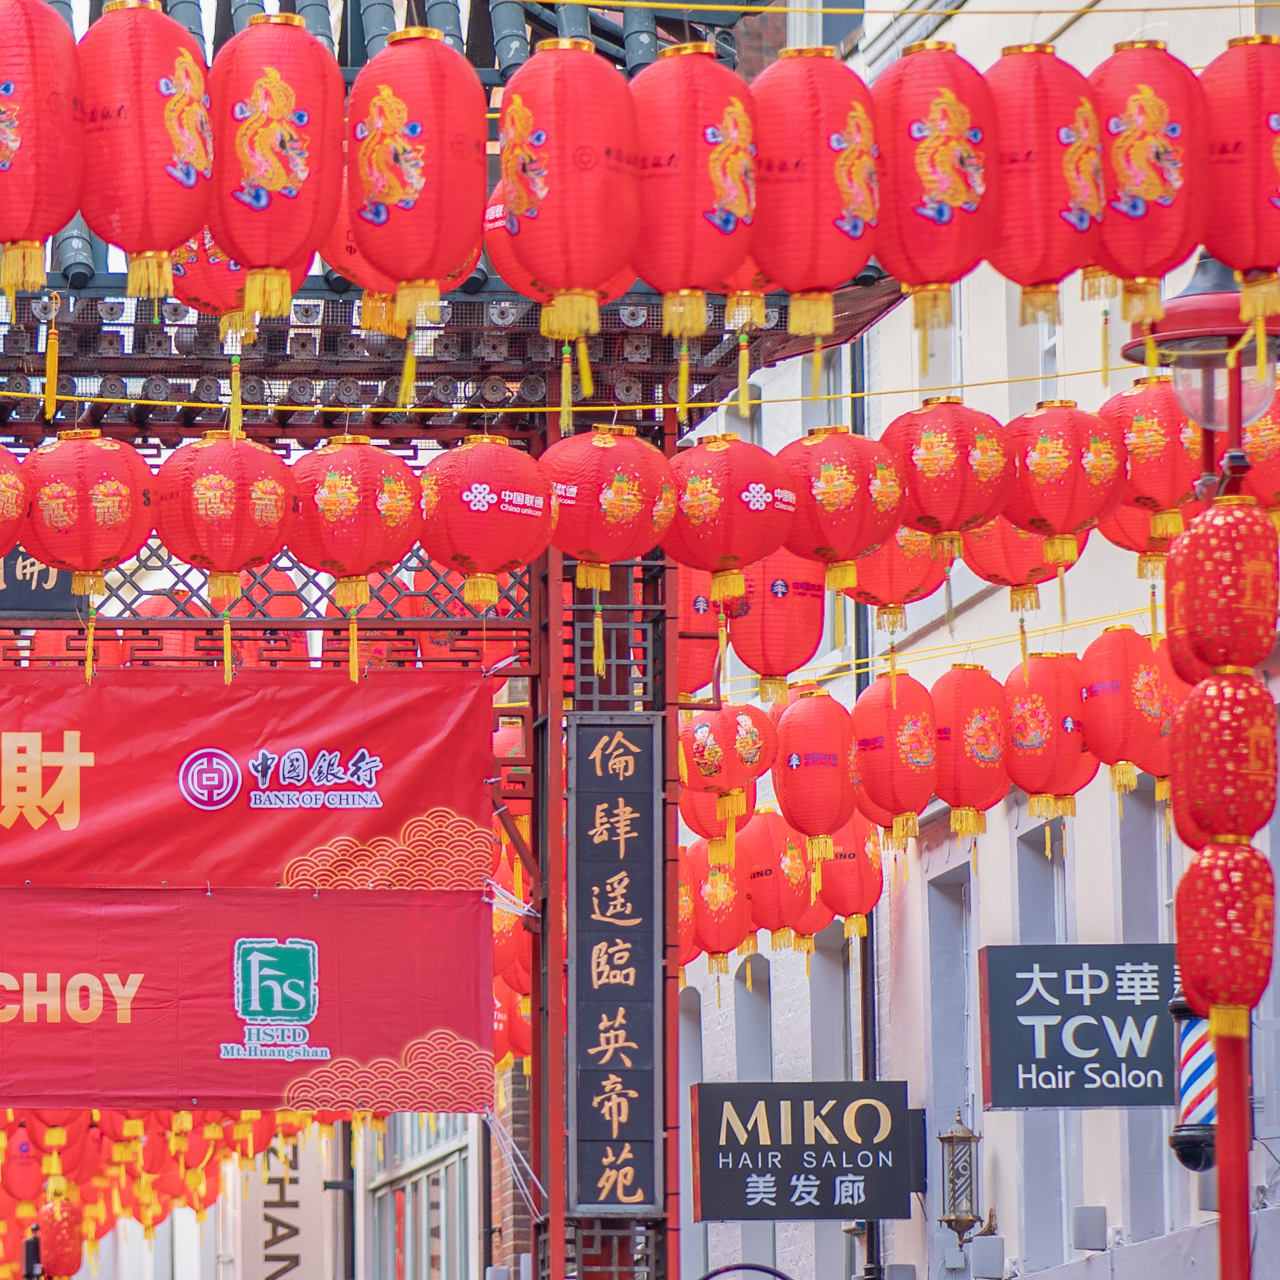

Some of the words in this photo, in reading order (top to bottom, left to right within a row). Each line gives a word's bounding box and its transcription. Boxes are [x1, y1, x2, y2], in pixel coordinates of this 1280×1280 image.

[500, 490, 545, 510] 中国联通
[250, 791, 297, 810] BANK
[299, 791, 321, 809] OF
[323, 791, 383, 810] CHINA
[1015, 962, 1181, 1007] 大中華
[245, 1026, 309, 1045] HSTD
[1016, 1014, 1159, 1059] TCW
[221, 1044, 331, 1062] Mt.Huangshan
[1017, 1063, 1076, 1090] Hair
[1083, 1062, 1164, 1090] Salon
[719, 1098, 893, 1146] MIKO
[719, 1152, 782, 1170] HAIR
[802, 1150, 894, 1169] SALON
[745, 1172, 867, 1206] 美发廊
